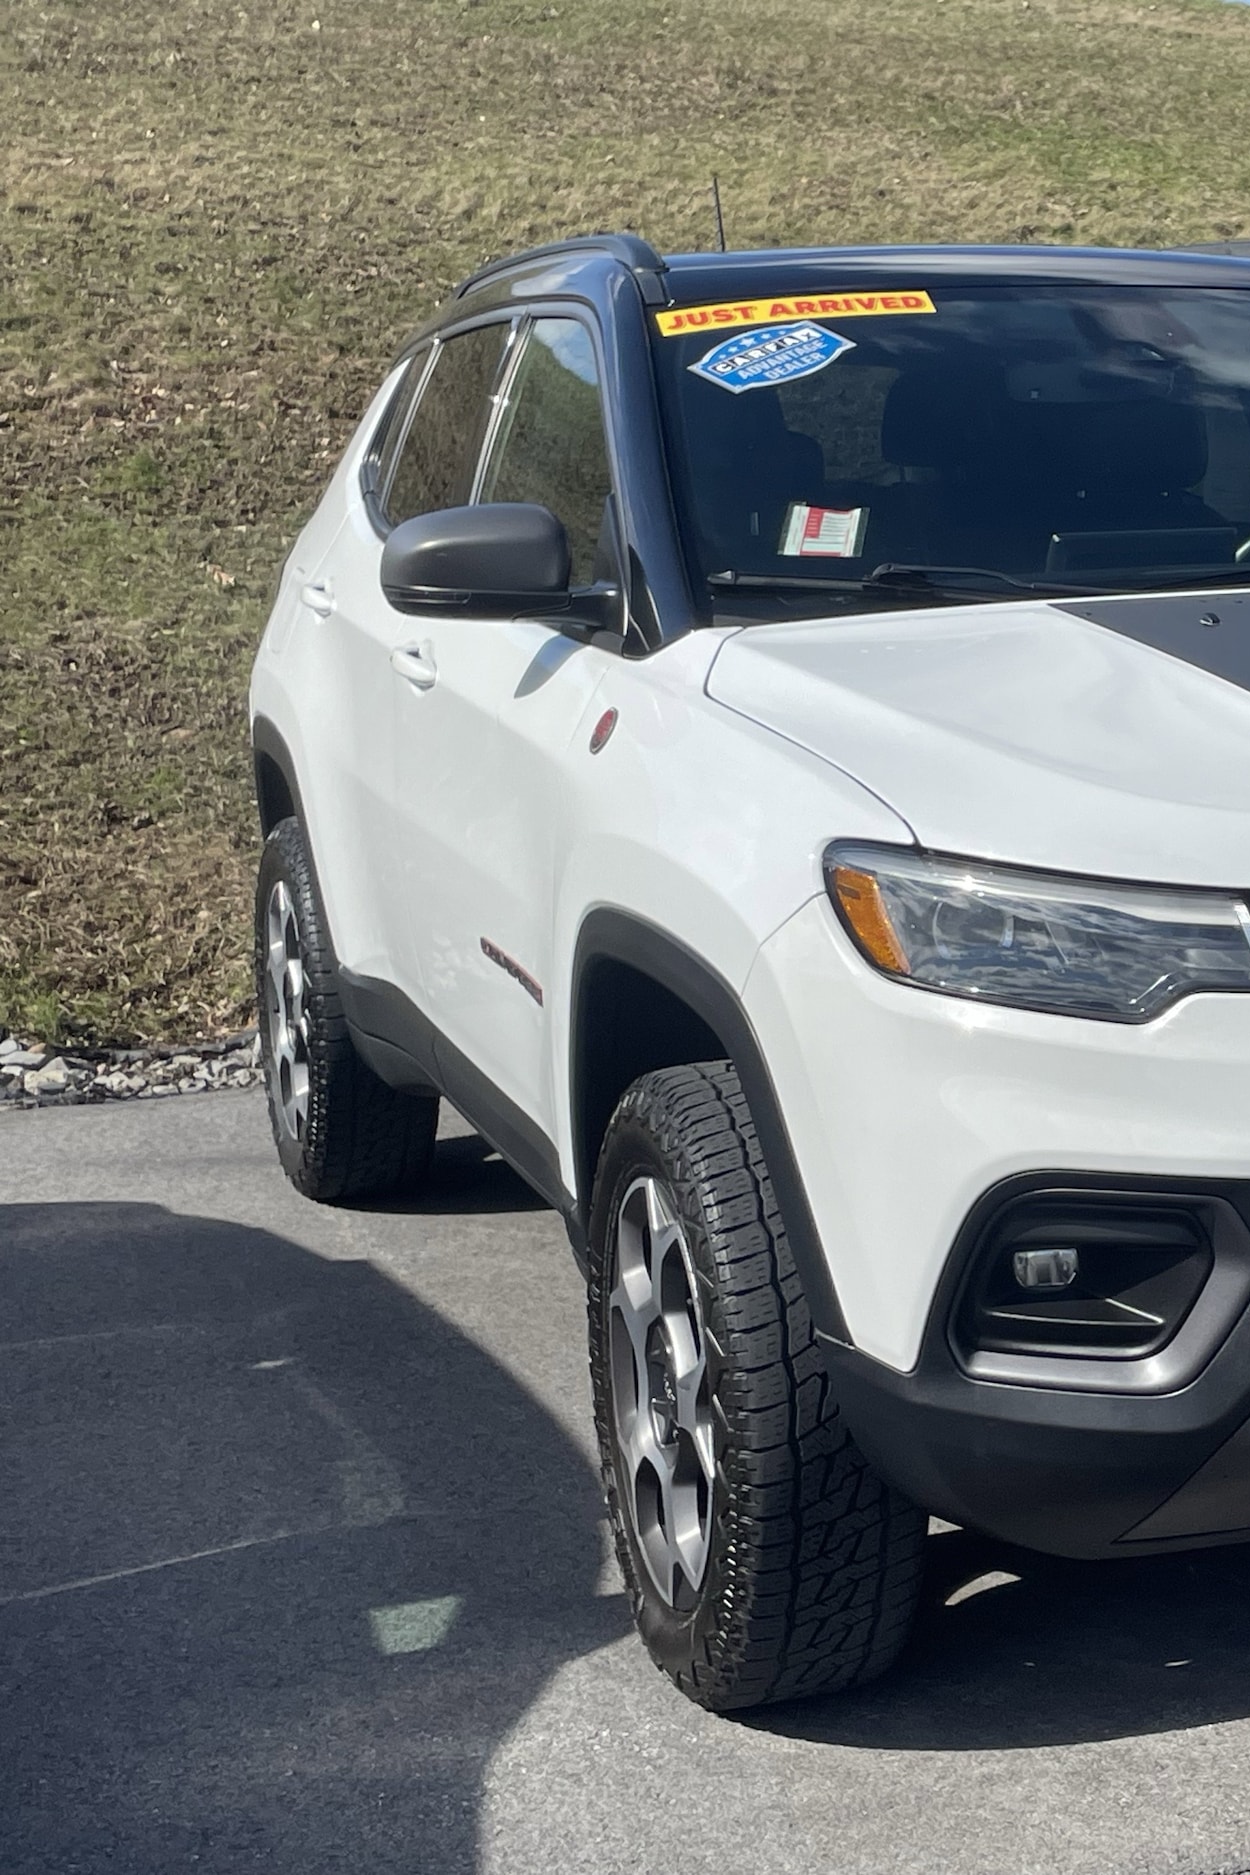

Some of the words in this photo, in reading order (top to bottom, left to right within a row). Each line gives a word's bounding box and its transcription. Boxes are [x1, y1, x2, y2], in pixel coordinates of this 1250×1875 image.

[668, 307, 756, 330] JUST
[769, 296, 926, 317] ARRIVED
[712, 329, 822, 373] CARFAX
[738, 338, 828, 379] ADVANTAGE
[767, 352, 826, 380] DEALER
